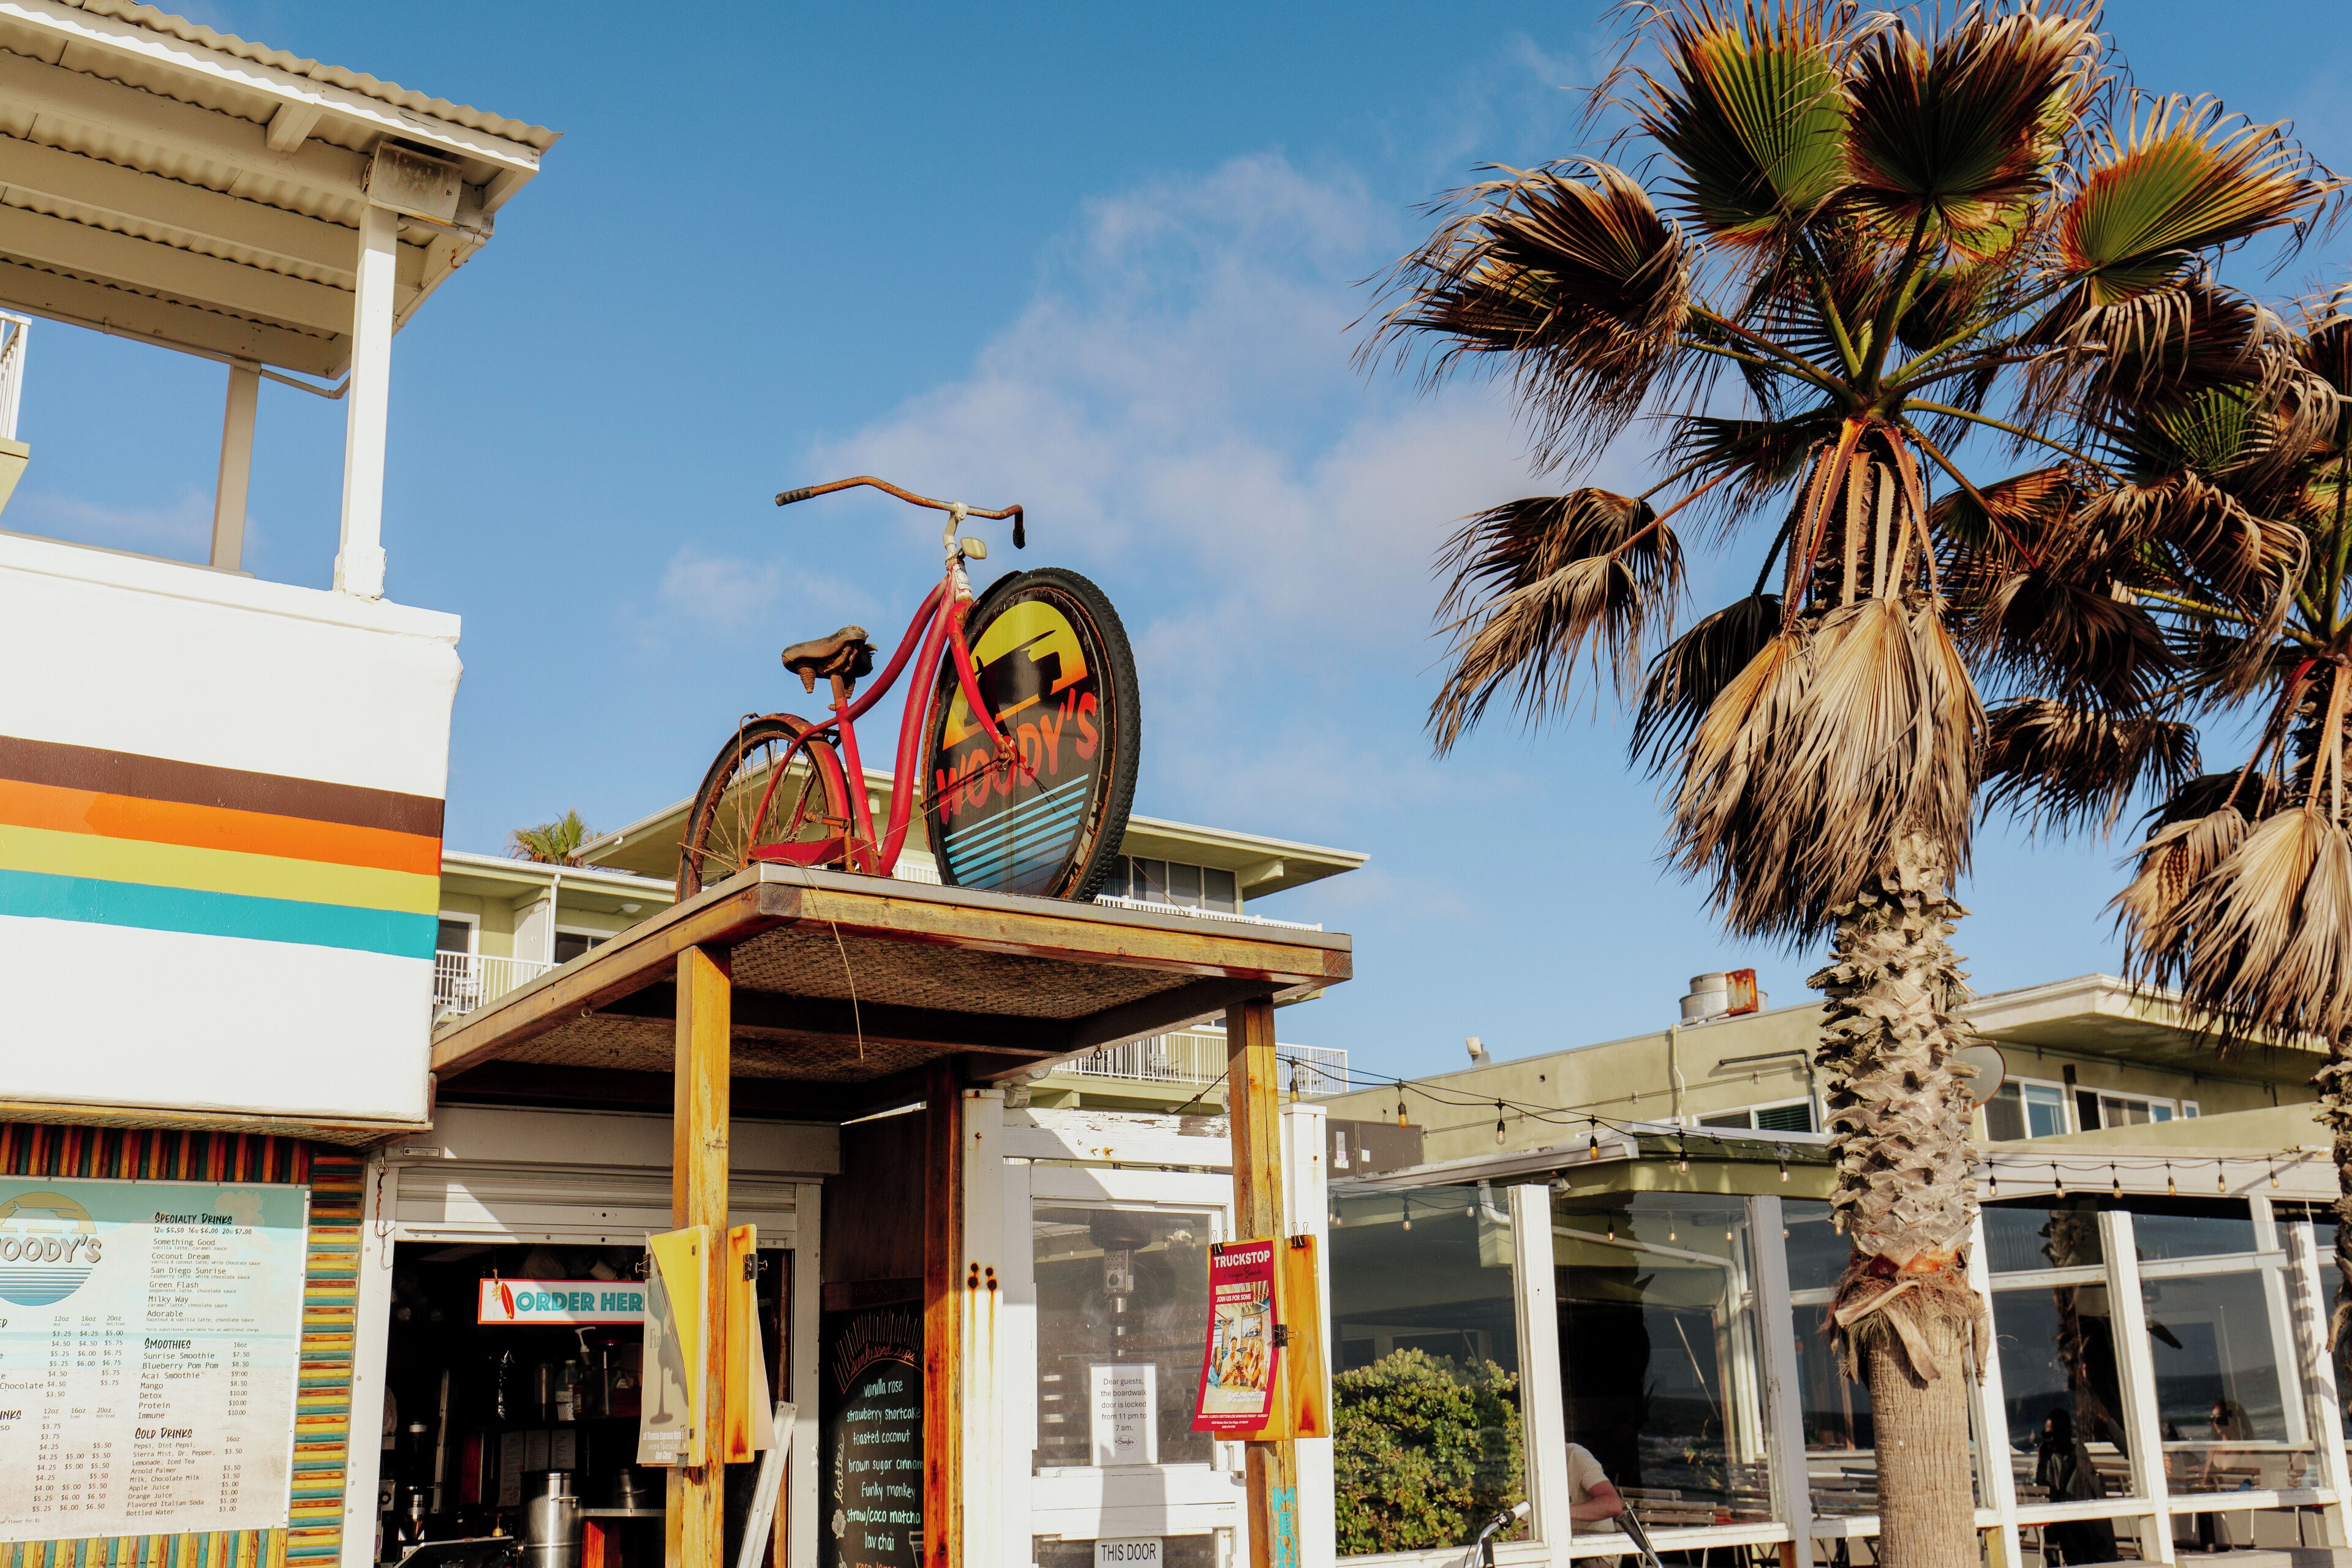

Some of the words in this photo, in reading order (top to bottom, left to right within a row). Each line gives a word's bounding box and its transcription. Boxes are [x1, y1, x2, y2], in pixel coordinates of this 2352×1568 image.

[935, 688, 1098, 826] WOODY'S
[155, 1212, 197, 1223] SPECIALTY
[202, 1213, 232, 1224] DRINKS
[0, 1234, 102, 1263] OODY'S
[1214, 1250, 1270, 1268] TRUCKSTOP
[516, 1292, 595, 1311] ORDER
[601, 1292, 645, 1311] HER
[145, 1338, 190, 1349] SMOOTHIES
[850, 1341, 894, 1376] sunkissed
[894, 1348, 918, 1363] sips
[864, 1379, 886, 1398] vanilla
[888, 1380, 903, 1393] rose
[847, 1408, 881, 1425] strawberry
[885, 1407, 921, 1420] shortcake
[135, 1428, 156, 1439] COLD
[161, 1428, 192, 1438] DRINKS
[853, 1430, 879, 1446] toasted
[882, 1430, 910, 1443] coconut
[834, 1433, 845, 1504] lattes
[848, 1458, 869, 1472] brown
[873, 1460, 892, 1475] sugar
[862, 1482, 883, 1501] funky
[887, 1482, 915, 1503] monkey
[847, 1506, 886, 1526] straw/coco
[890, 1510, 921, 1524] matcha
[1273, 1487, 1295, 1568] MEN
[865, 1532, 876, 1548] lav
[878, 1533, 894, 1550] chai
[1101, 1544, 1123, 1561] THIS
[1127, 1543, 1156, 1560] DOOR
